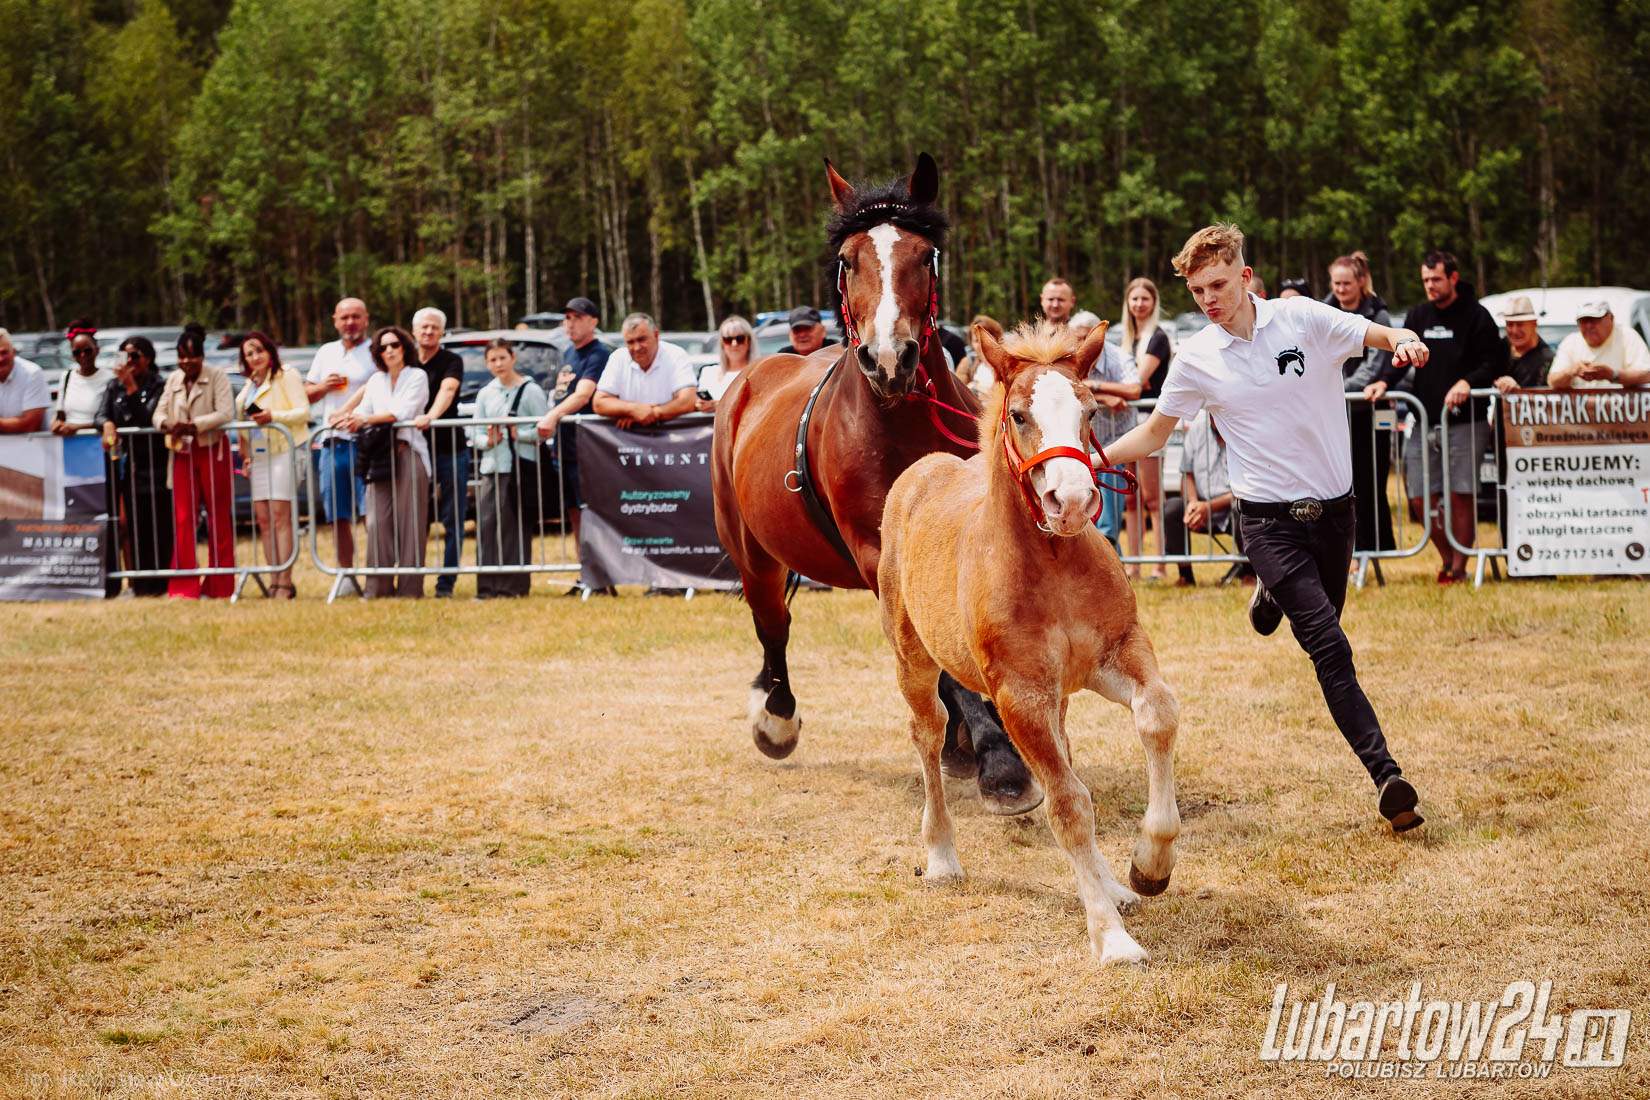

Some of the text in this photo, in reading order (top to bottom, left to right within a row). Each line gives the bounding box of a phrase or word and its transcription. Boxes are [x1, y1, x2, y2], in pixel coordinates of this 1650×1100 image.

[1506, 393, 1590, 426] TARTAK
[1515, 455, 1640, 472] OFERUJEMY:
[1576, 474, 1634, 487] dachową
[620, 490, 691, 501] Autoryzowany
[1527, 493, 1562, 503] deski
[620, 503, 678, 515] dystrybutor
[1527, 507, 1648, 521] obrzynki tartaczne
[1528, 524, 1633, 537] usługi tartaczne
[1538, 549, 1614, 560] 726 717 514
